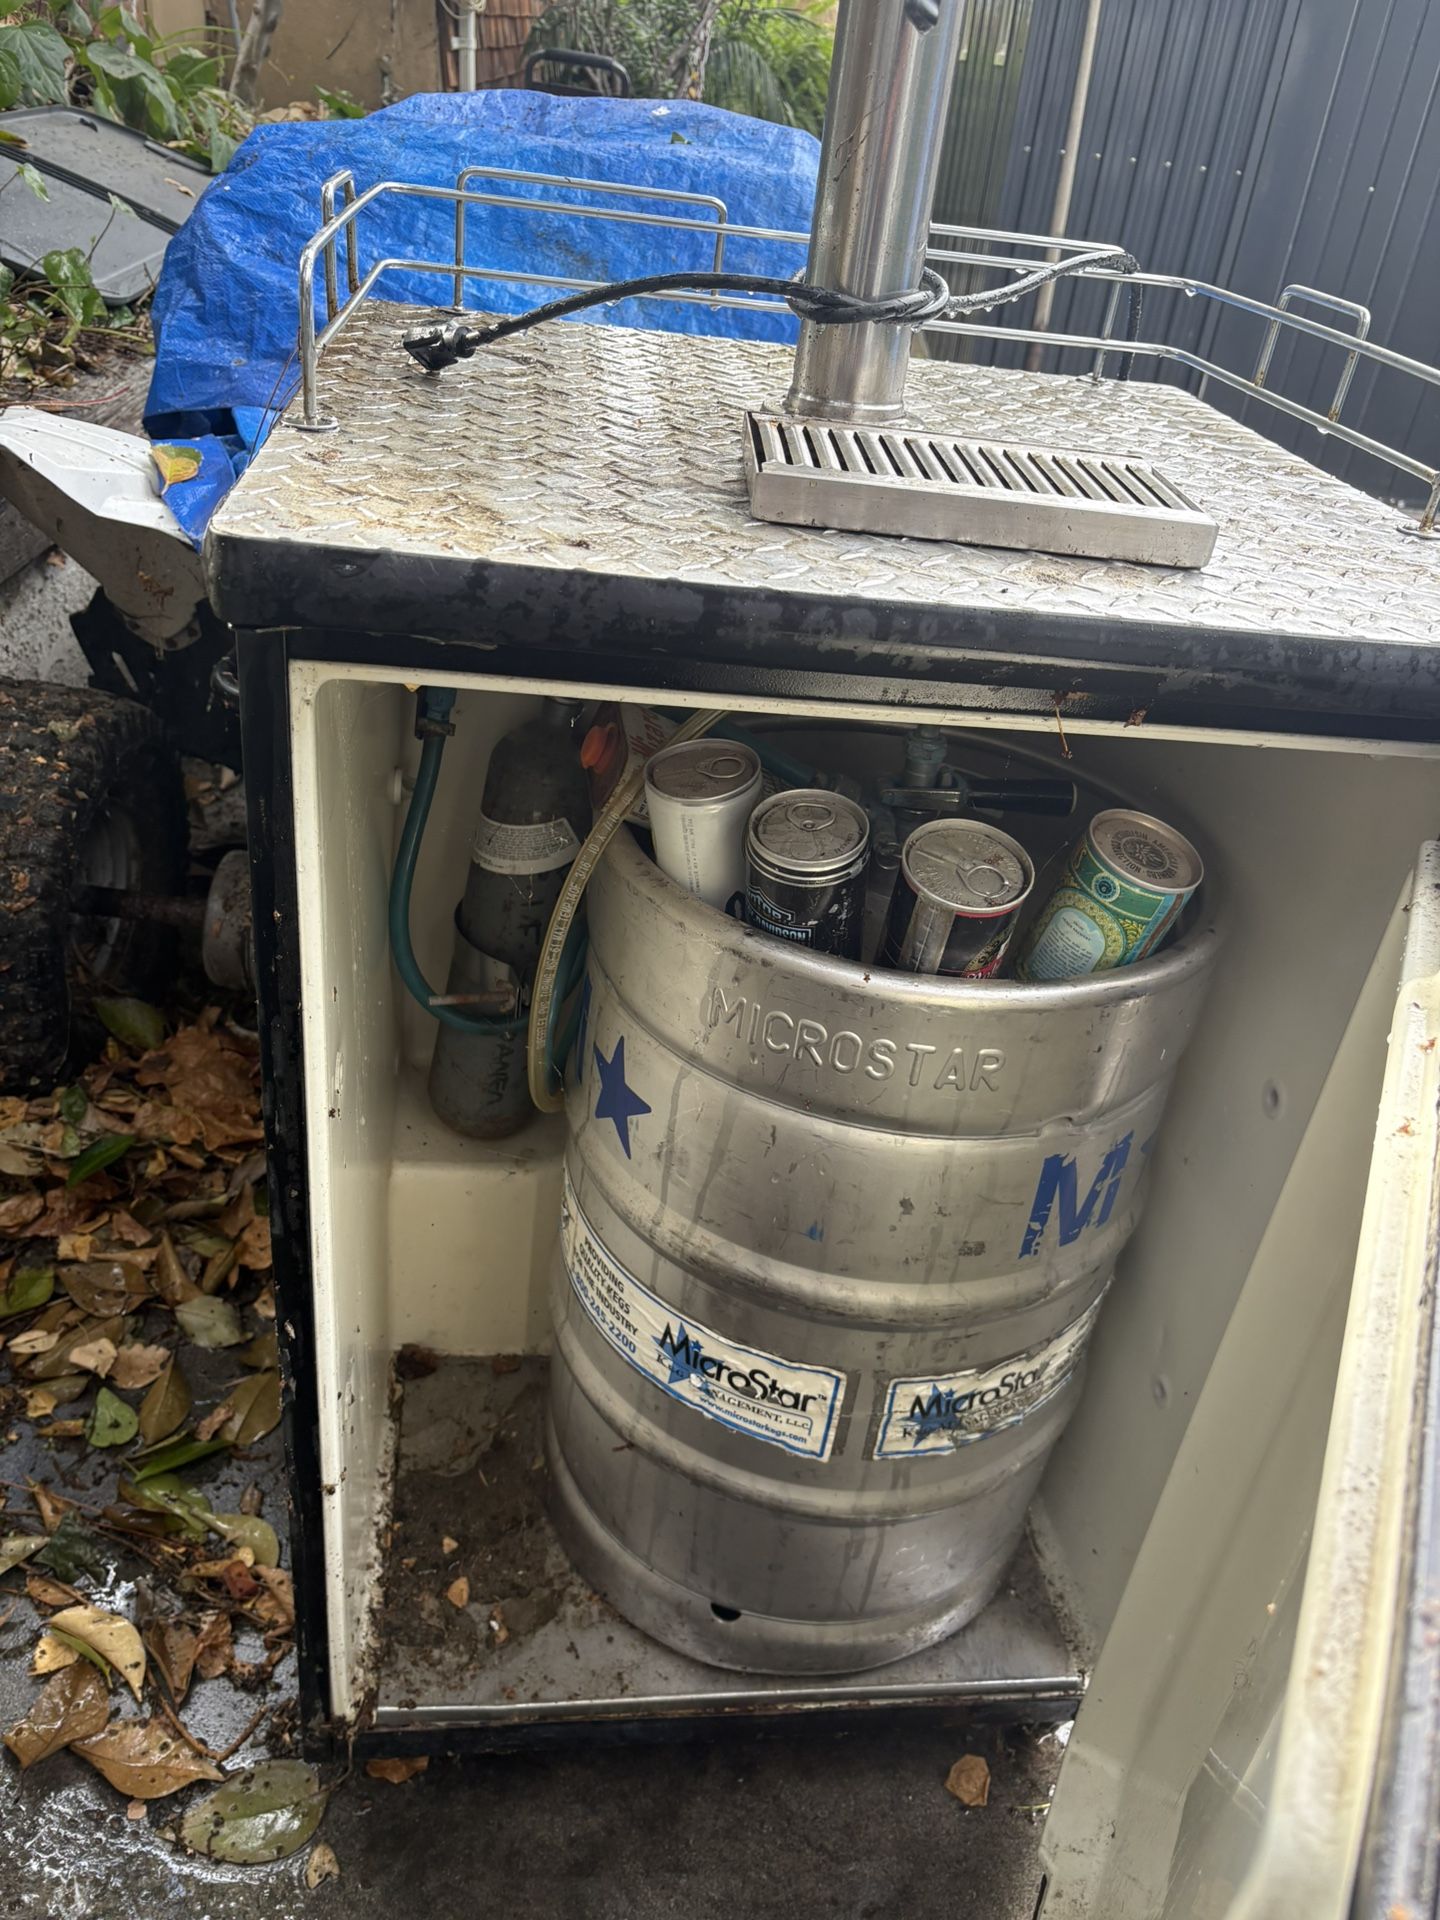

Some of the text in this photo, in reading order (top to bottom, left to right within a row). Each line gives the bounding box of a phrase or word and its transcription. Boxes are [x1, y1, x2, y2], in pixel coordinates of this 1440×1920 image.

[552, 925, 568, 941] MAX
[708, 987, 1006, 1092] MICROSTAR
[579, 1243, 631, 1315] QUALITY KEGS
[584, 1236, 625, 1293] PROVIDING
[583, 1265, 596, 1292] THE
[595, 1289, 639, 1336] INDUSTRY
